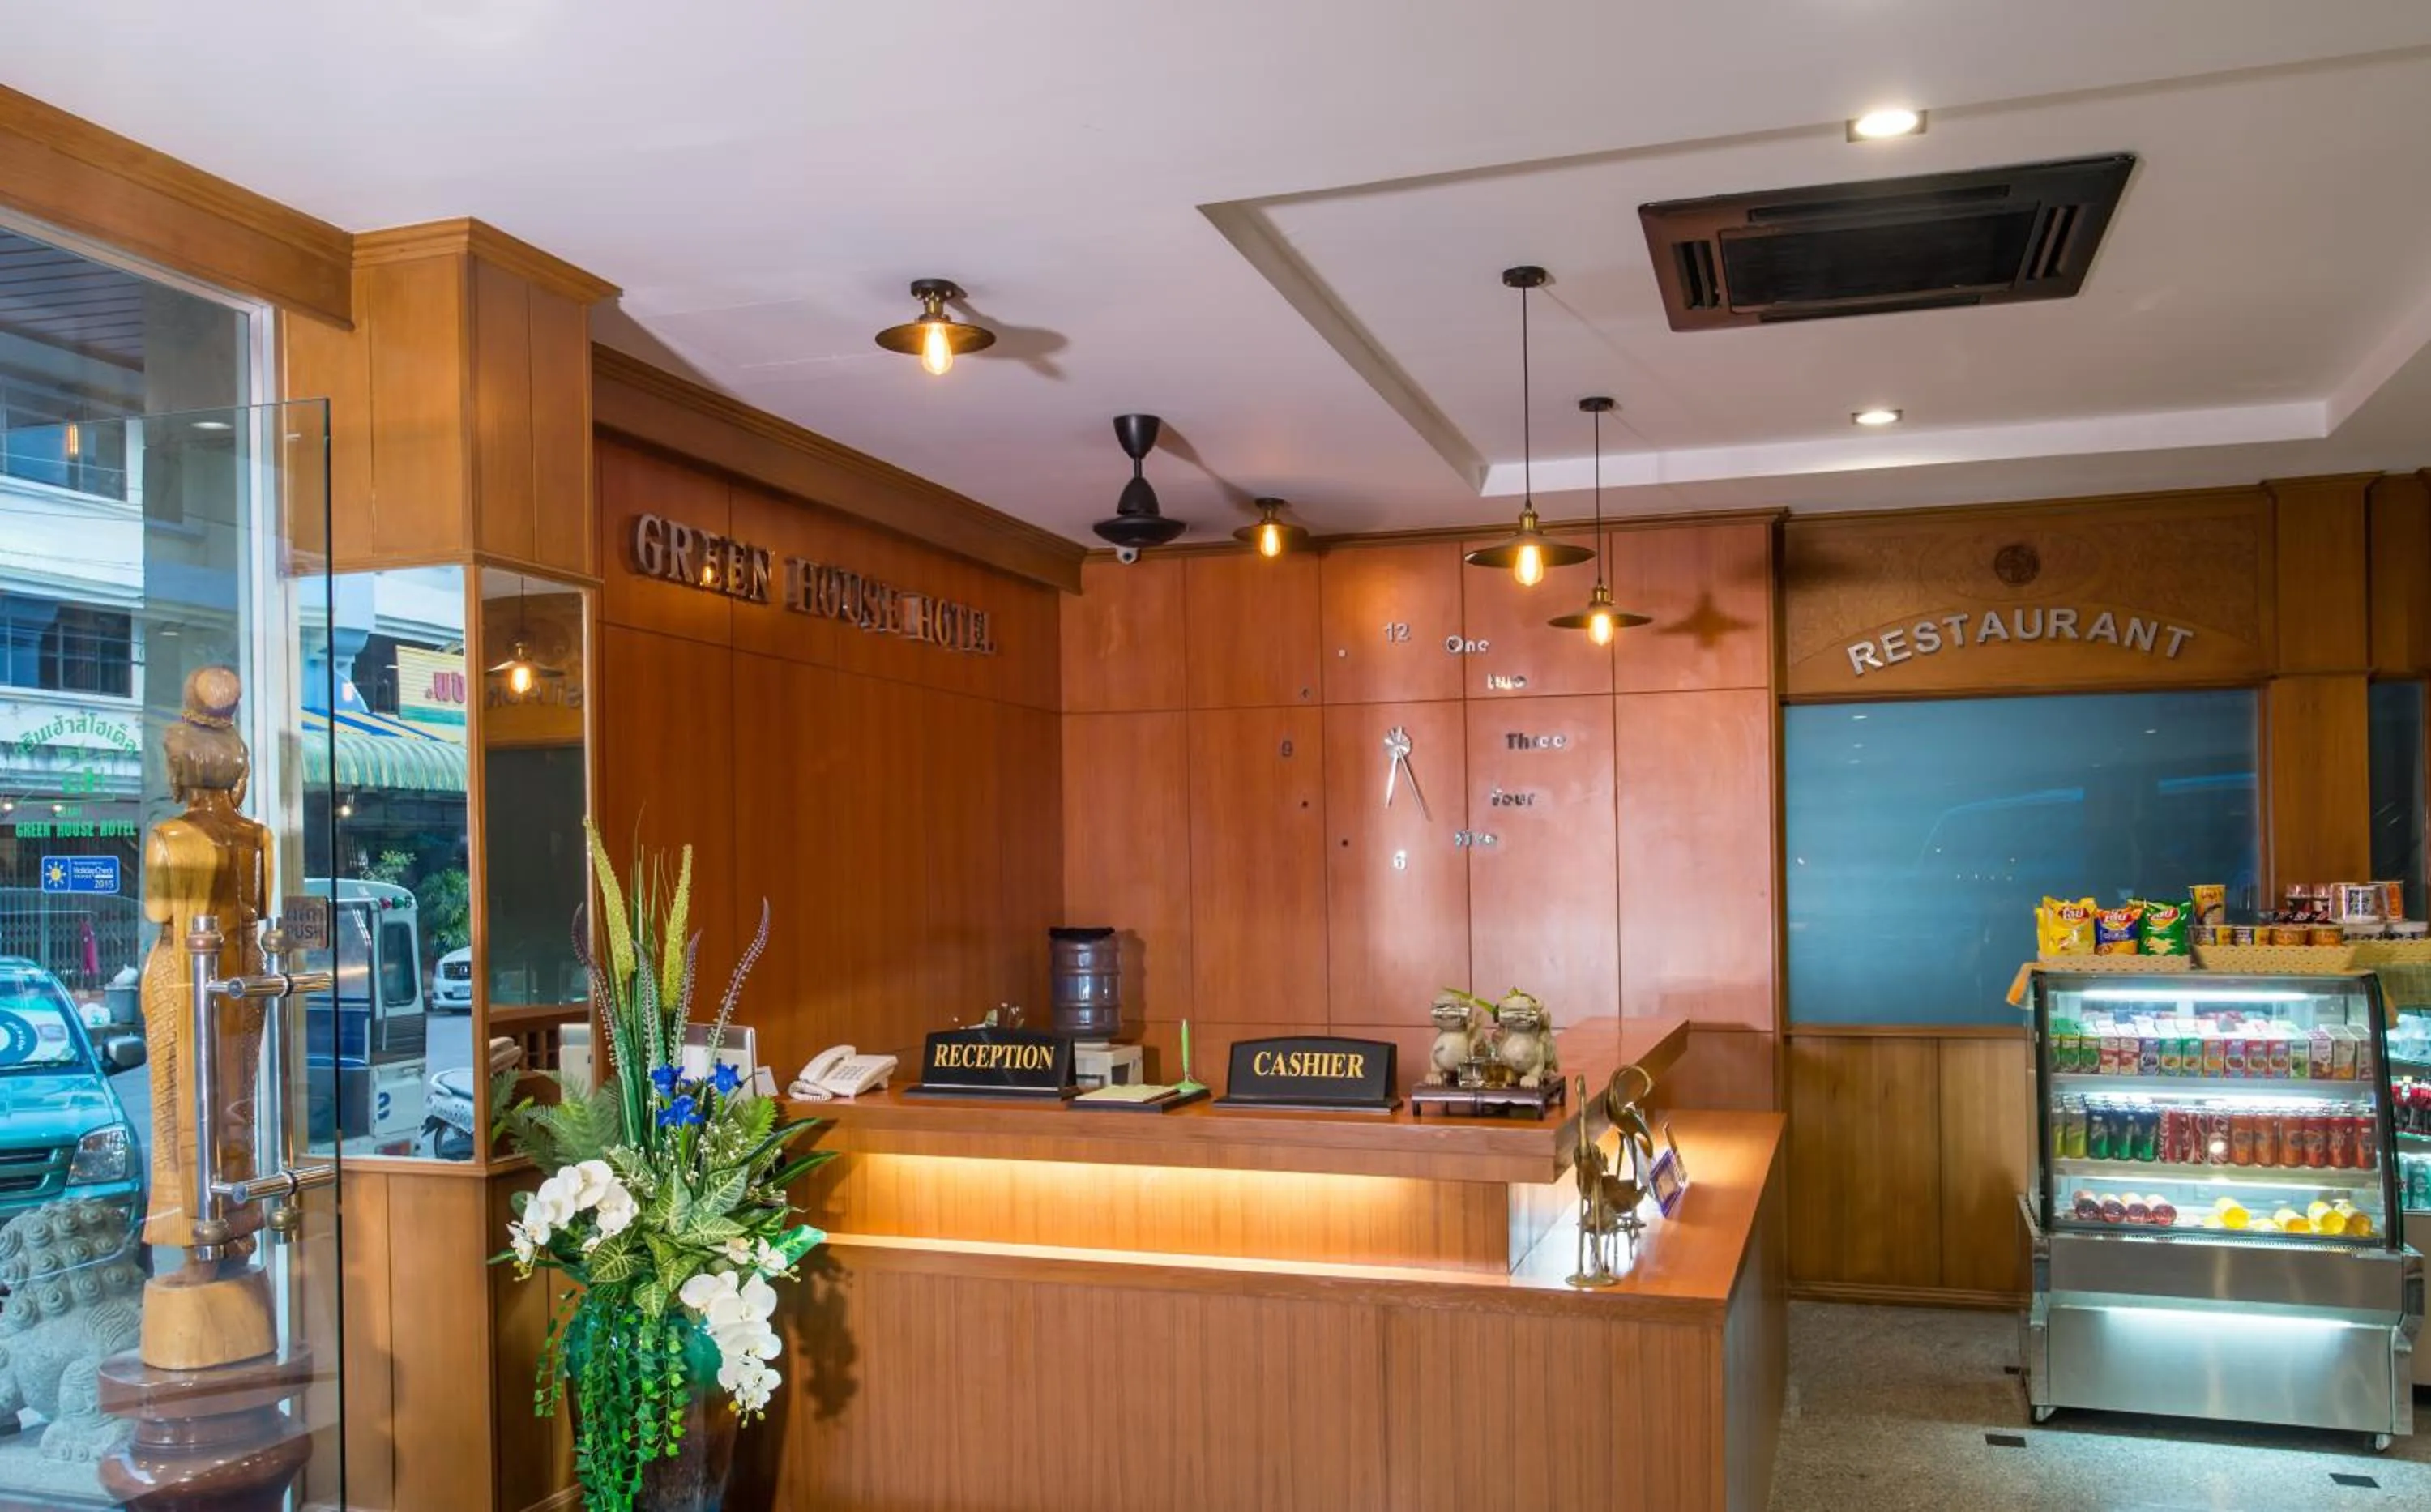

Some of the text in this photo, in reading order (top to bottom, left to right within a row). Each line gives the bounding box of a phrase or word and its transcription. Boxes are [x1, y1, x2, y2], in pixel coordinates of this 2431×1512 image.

[637, 513, 997, 655] GREEN HOUSE HOTEL
[1386, 622, 1411, 643] 12
[1847, 609, 2194, 676] RESTAURANT
[1446, 635, 1490, 652] One
[1506, 733, 1566, 750] Three
[15, 818, 137, 838] GREEN HOUSE HOTEL
[1392, 850, 1407, 869] 6
[94, 879, 114, 889] 2015
[286, 925, 323, 939] PUSH
[934, 1044, 1055, 1070] RECEPTION
[1254, 1051, 1365, 1078] CASHIER
